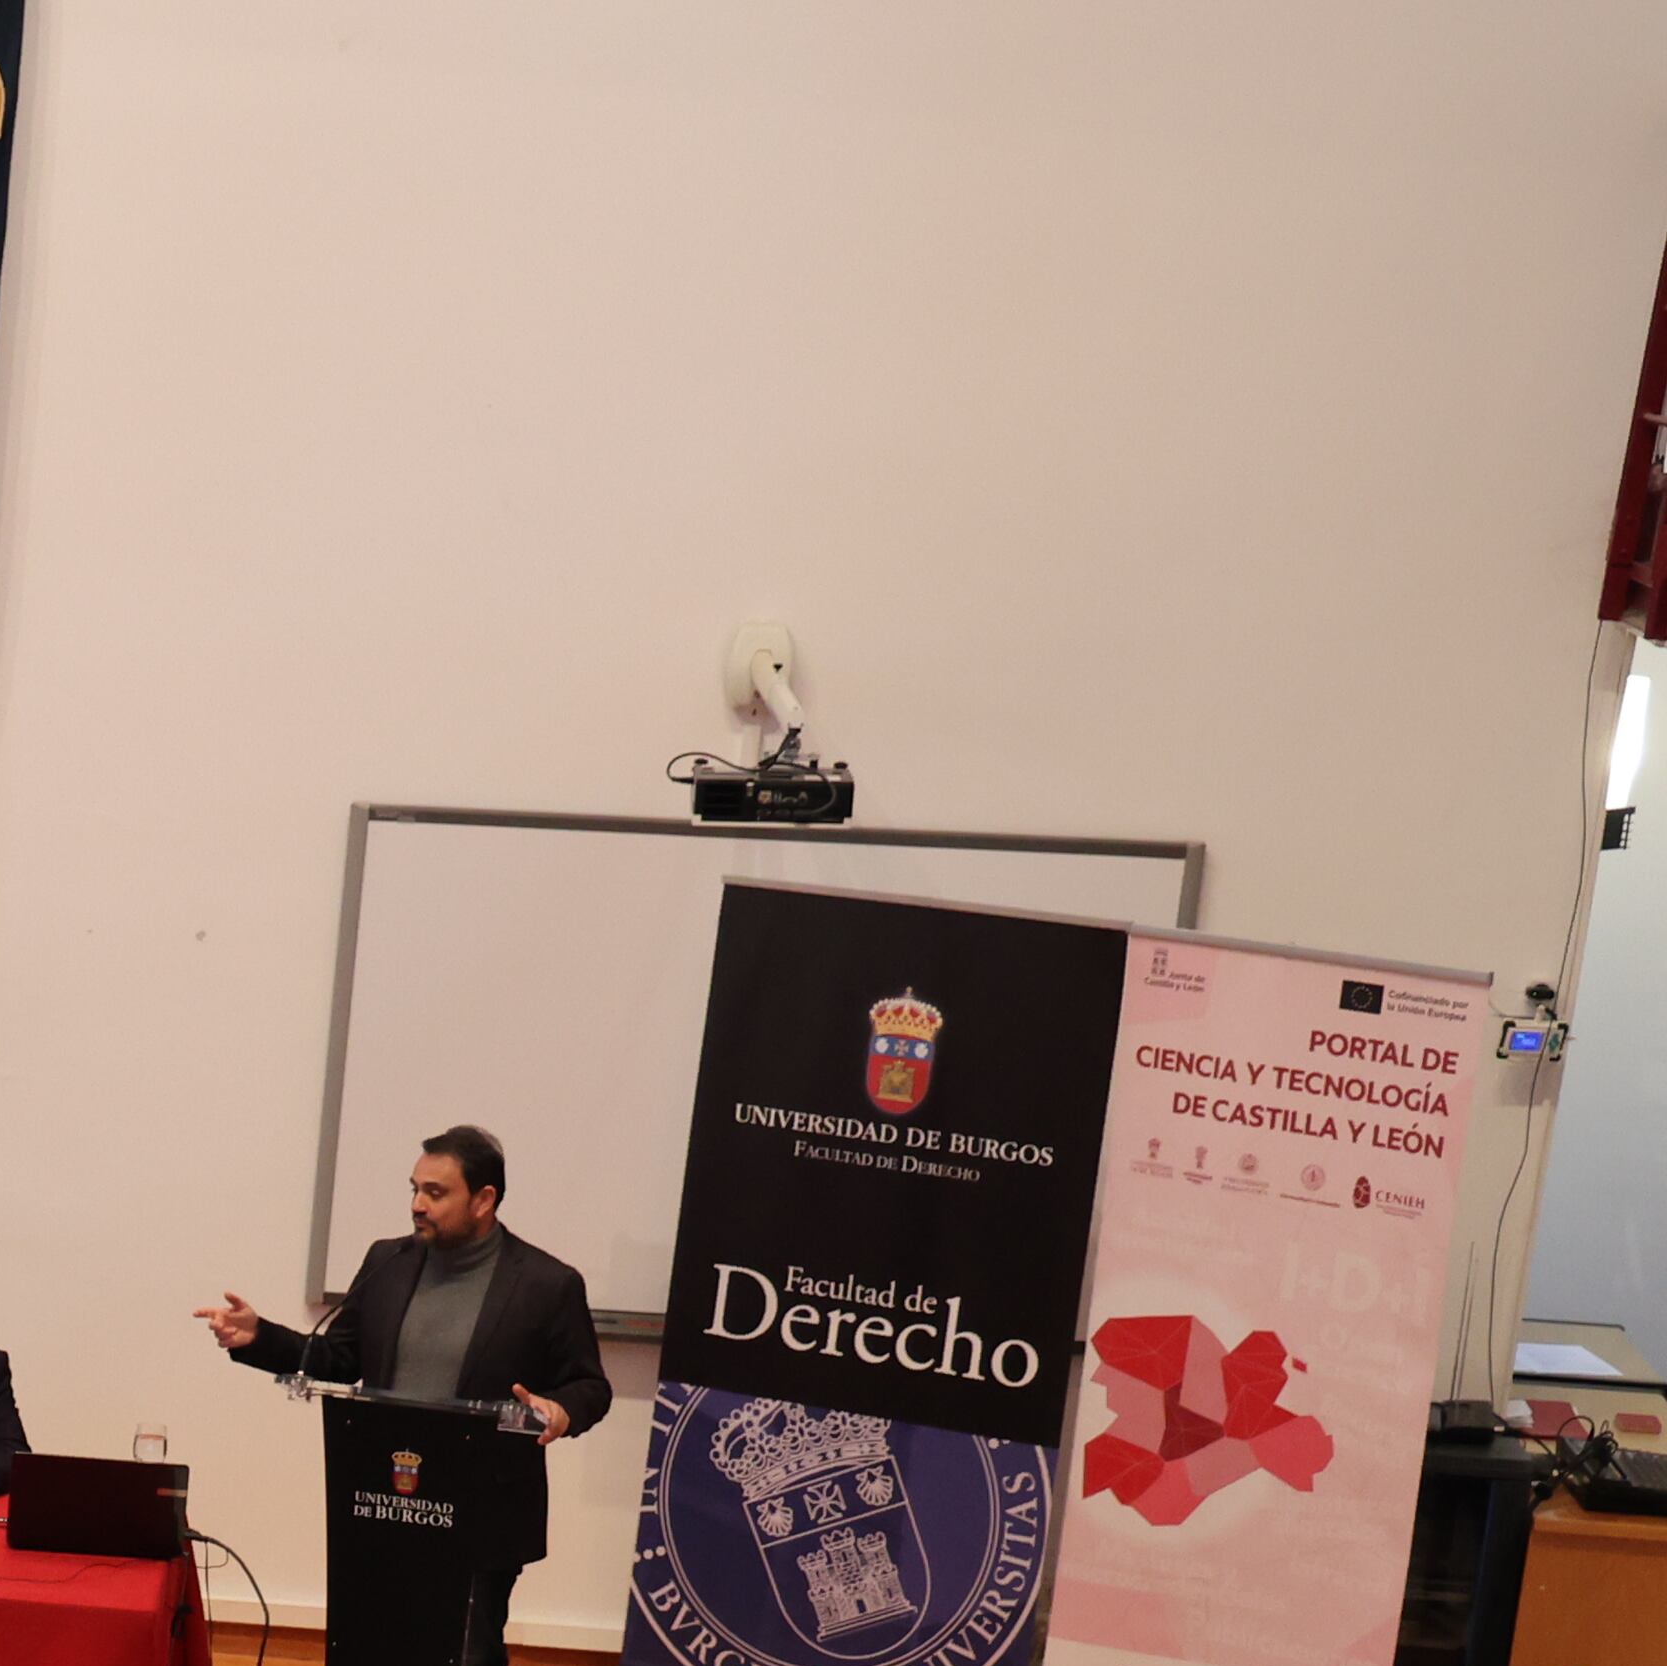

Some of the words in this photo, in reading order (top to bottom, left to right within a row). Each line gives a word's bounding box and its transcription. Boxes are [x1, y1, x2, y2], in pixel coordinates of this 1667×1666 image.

[1388, 989, 1451, 1007] Cofinanciado
[1452, 1000, 1469, 1009] por
[1427, 1008, 1467, 1022] Europea
[1308, 1029, 1415, 1070] PORTAL
[1421, 1047, 1460, 1076] DE
[1135, 1044, 1238, 1083] CIENCIA
[1246, 1062, 1266, 1087] Y
[1272, 1066, 1450, 1117] TECNOLOGÍA
[734, 1102, 898, 1145] UNIVERSIDAD
[904, 1126, 943, 1152] DE
[948, 1132, 1055, 1168] BURGOS
[1171, 1091, 1208, 1118] DE
[1211, 1098, 1339, 1141] CASTILLA
[1347, 1119, 1367, 1145] Y
[1371, 1122, 1446, 1159] LEÓN
[1375, 1189, 1426, 1209] CENIEH
[783, 1264, 897, 1309] Facultad
[903, 1284, 938, 1315] de
[702, 1262, 1040, 1389] Derecho
[353, 1504, 373, 1518] DE
[375, 1505, 454, 1528] BURGOS
[354, 1490, 455, 1514] UNIVERSIDAD
